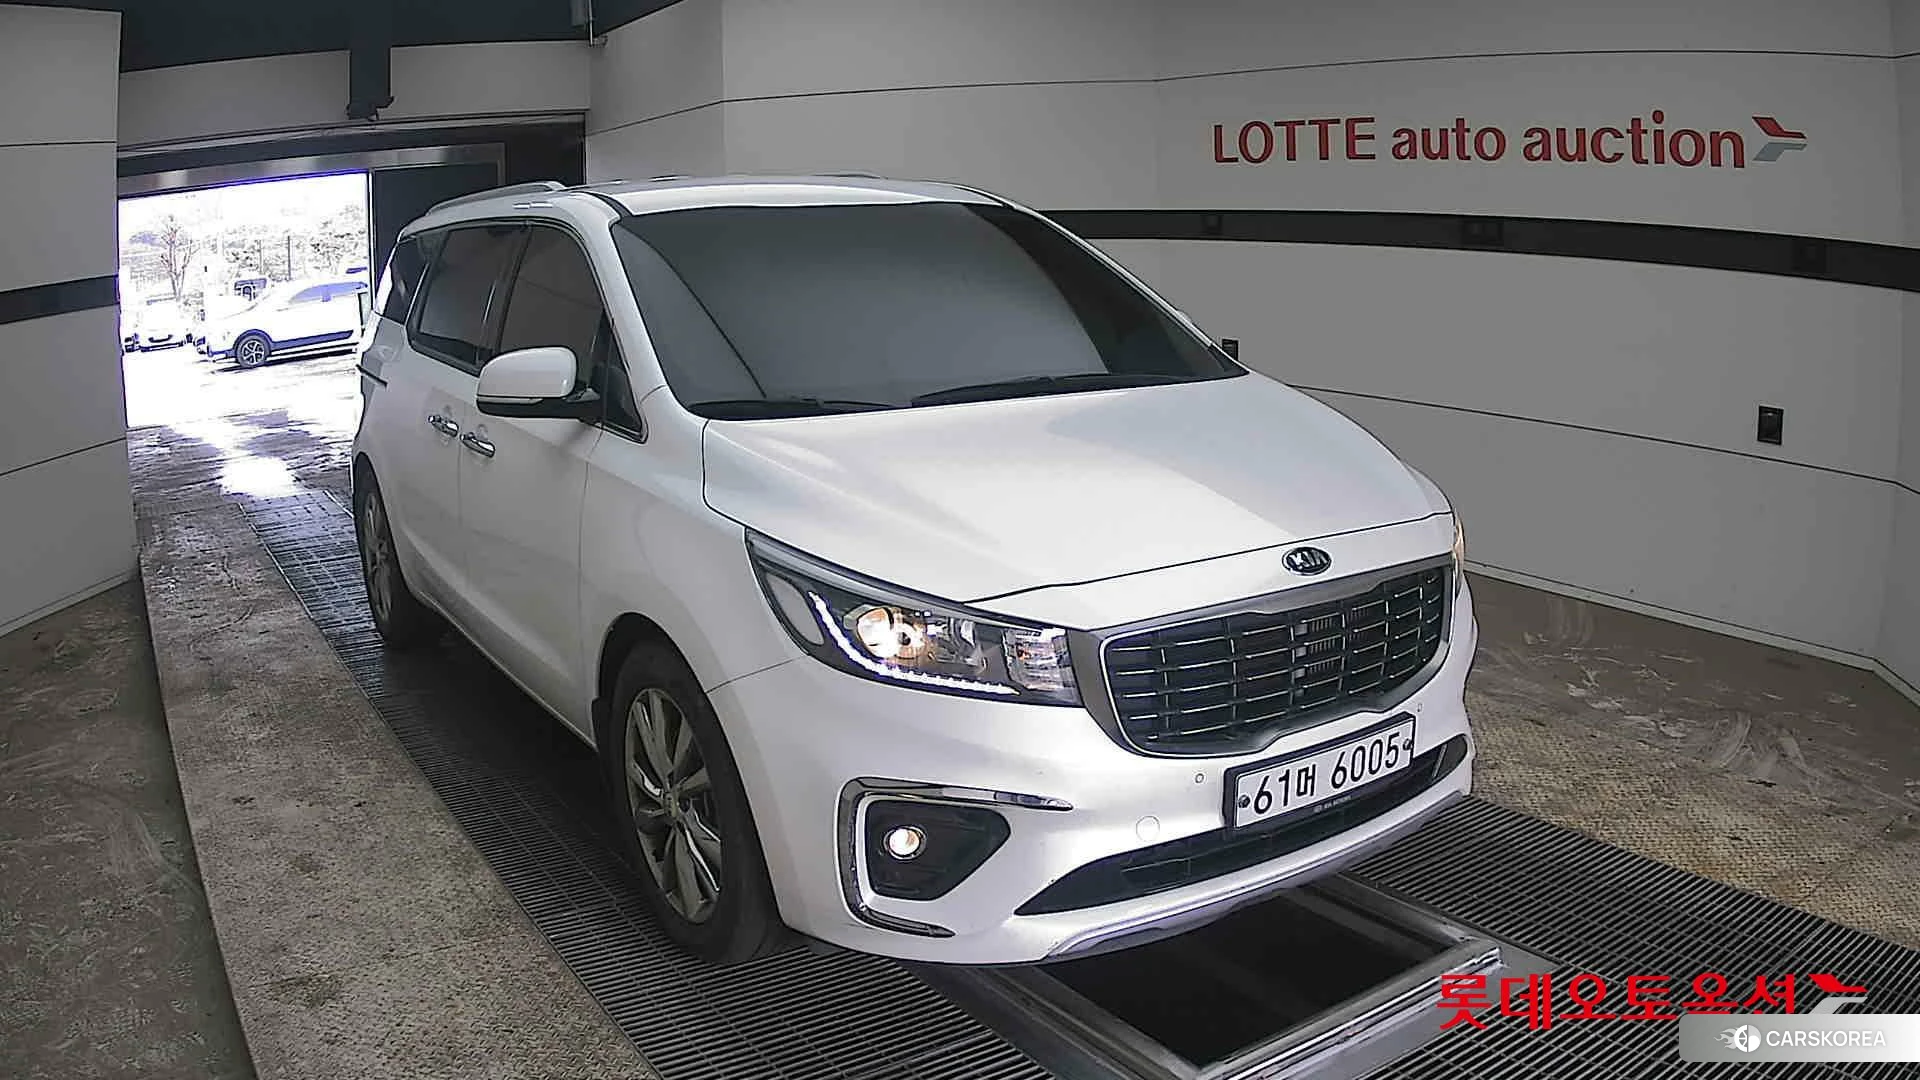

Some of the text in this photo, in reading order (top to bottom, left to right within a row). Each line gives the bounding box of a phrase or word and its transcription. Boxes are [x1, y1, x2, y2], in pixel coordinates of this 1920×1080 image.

[1213, 110, 1746, 169] LOTTE auto auction
[1289, 549, 1328, 569] KIA
[1253, 731, 1401, 815] 61머 6005
